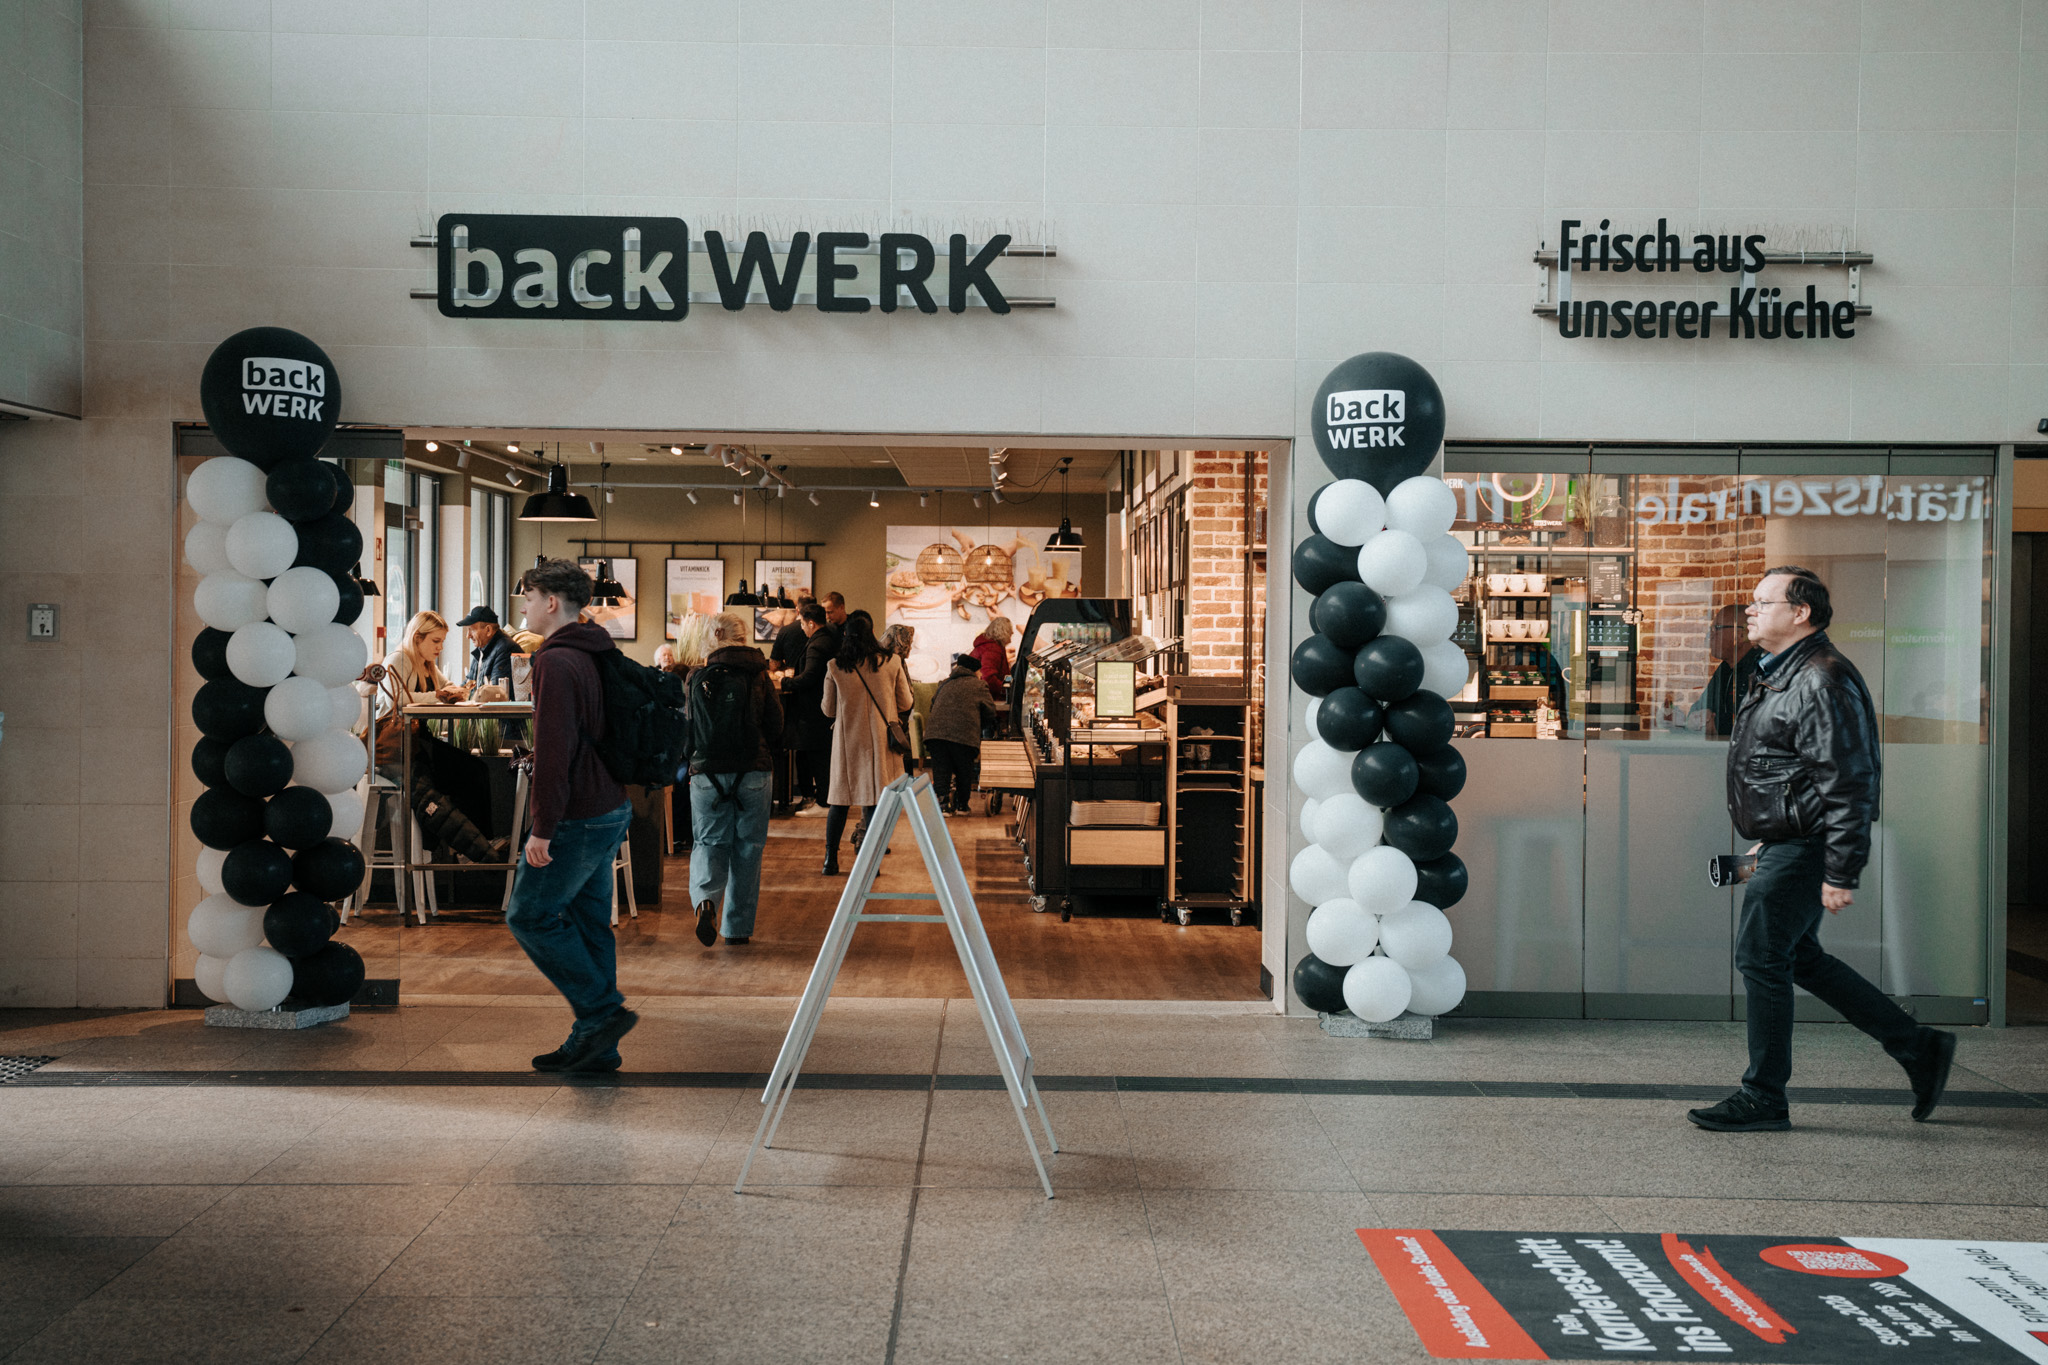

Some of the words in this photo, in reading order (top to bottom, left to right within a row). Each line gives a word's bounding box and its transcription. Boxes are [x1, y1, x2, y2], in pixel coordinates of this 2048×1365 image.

[1558, 218, 1681, 273] Frisch
[1692, 233, 1767, 274] aus
[450, 223, 676, 311] back
[704, 230, 1012, 314] WERK
[1558, 300, 1719, 339] unserer
[1729, 285, 1856, 339] Küche
[246, 360, 322, 394] back
[241, 392, 325, 422] WERK
[1330, 392, 1401, 422] back
[1327, 425, 1406, 450] WERK
[1395, 1235, 1432, 1265] Studium?
[1418, 1264, 1448, 1288] duales
[1574, 1238, 1703, 1323] Finanzamt!
[1434, 1287, 1460, 1305] oder
[1515, 1238, 1658, 1351] Karriereschritt
[1818, 1294, 1870, 1317] 2026
[1964, 1276, 2048, 1323] Finanzamt
[1447, 1305, 1491, 1348] Ausbildung
[1552, 1313, 1590, 1336] Dein
[1874, 1304, 1911, 1321] uns
[1898, 1301, 1959, 1329] Team!
[1674, 1325, 1734, 1353] ins
[1856, 1316, 1910, 1346] Starte
[1891, 1321, 1936, 1338] bei
[1948, 1329, 1982, 1343] im
